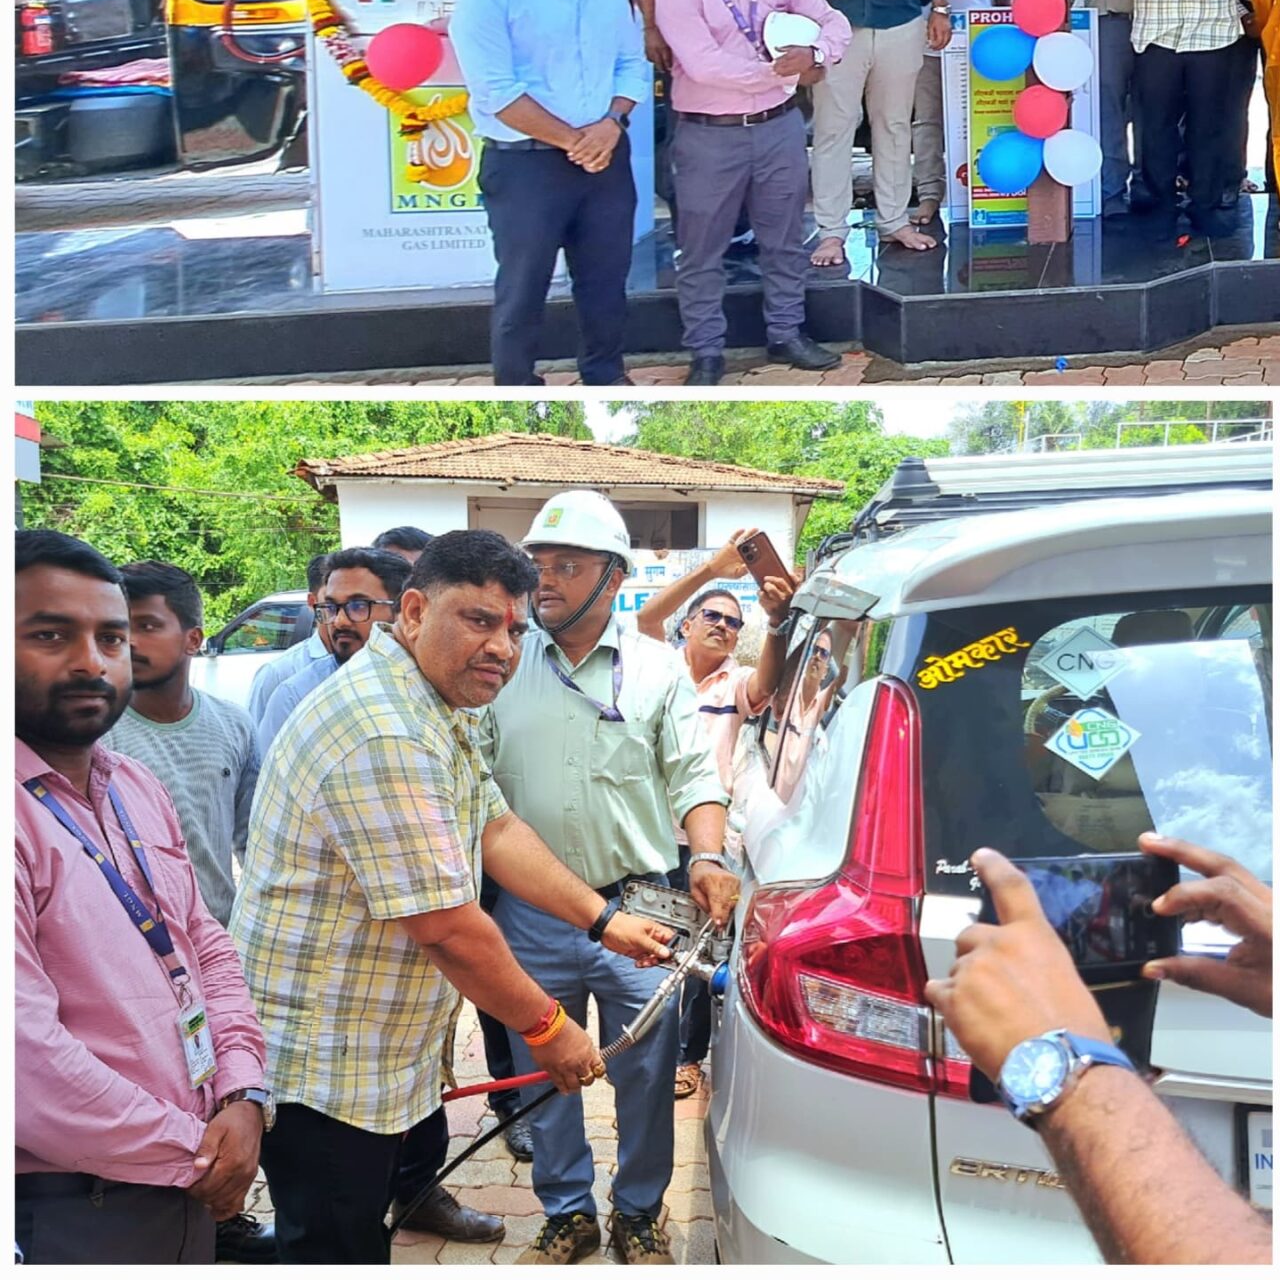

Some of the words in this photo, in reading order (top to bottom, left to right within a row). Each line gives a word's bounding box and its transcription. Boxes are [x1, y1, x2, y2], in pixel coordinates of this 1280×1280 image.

[970, 11, 1013, 24] PROH
[362, 225, 462, 238] MAHARASHTRA
[464, 224, 489, 235] NAT
[401, 240, 429, 251] GAS
[431, 239, 486, 250] LIMITED
[916, 626, 1031, 690] ओमकार
[1056, 652, 1117, 672] CNG
